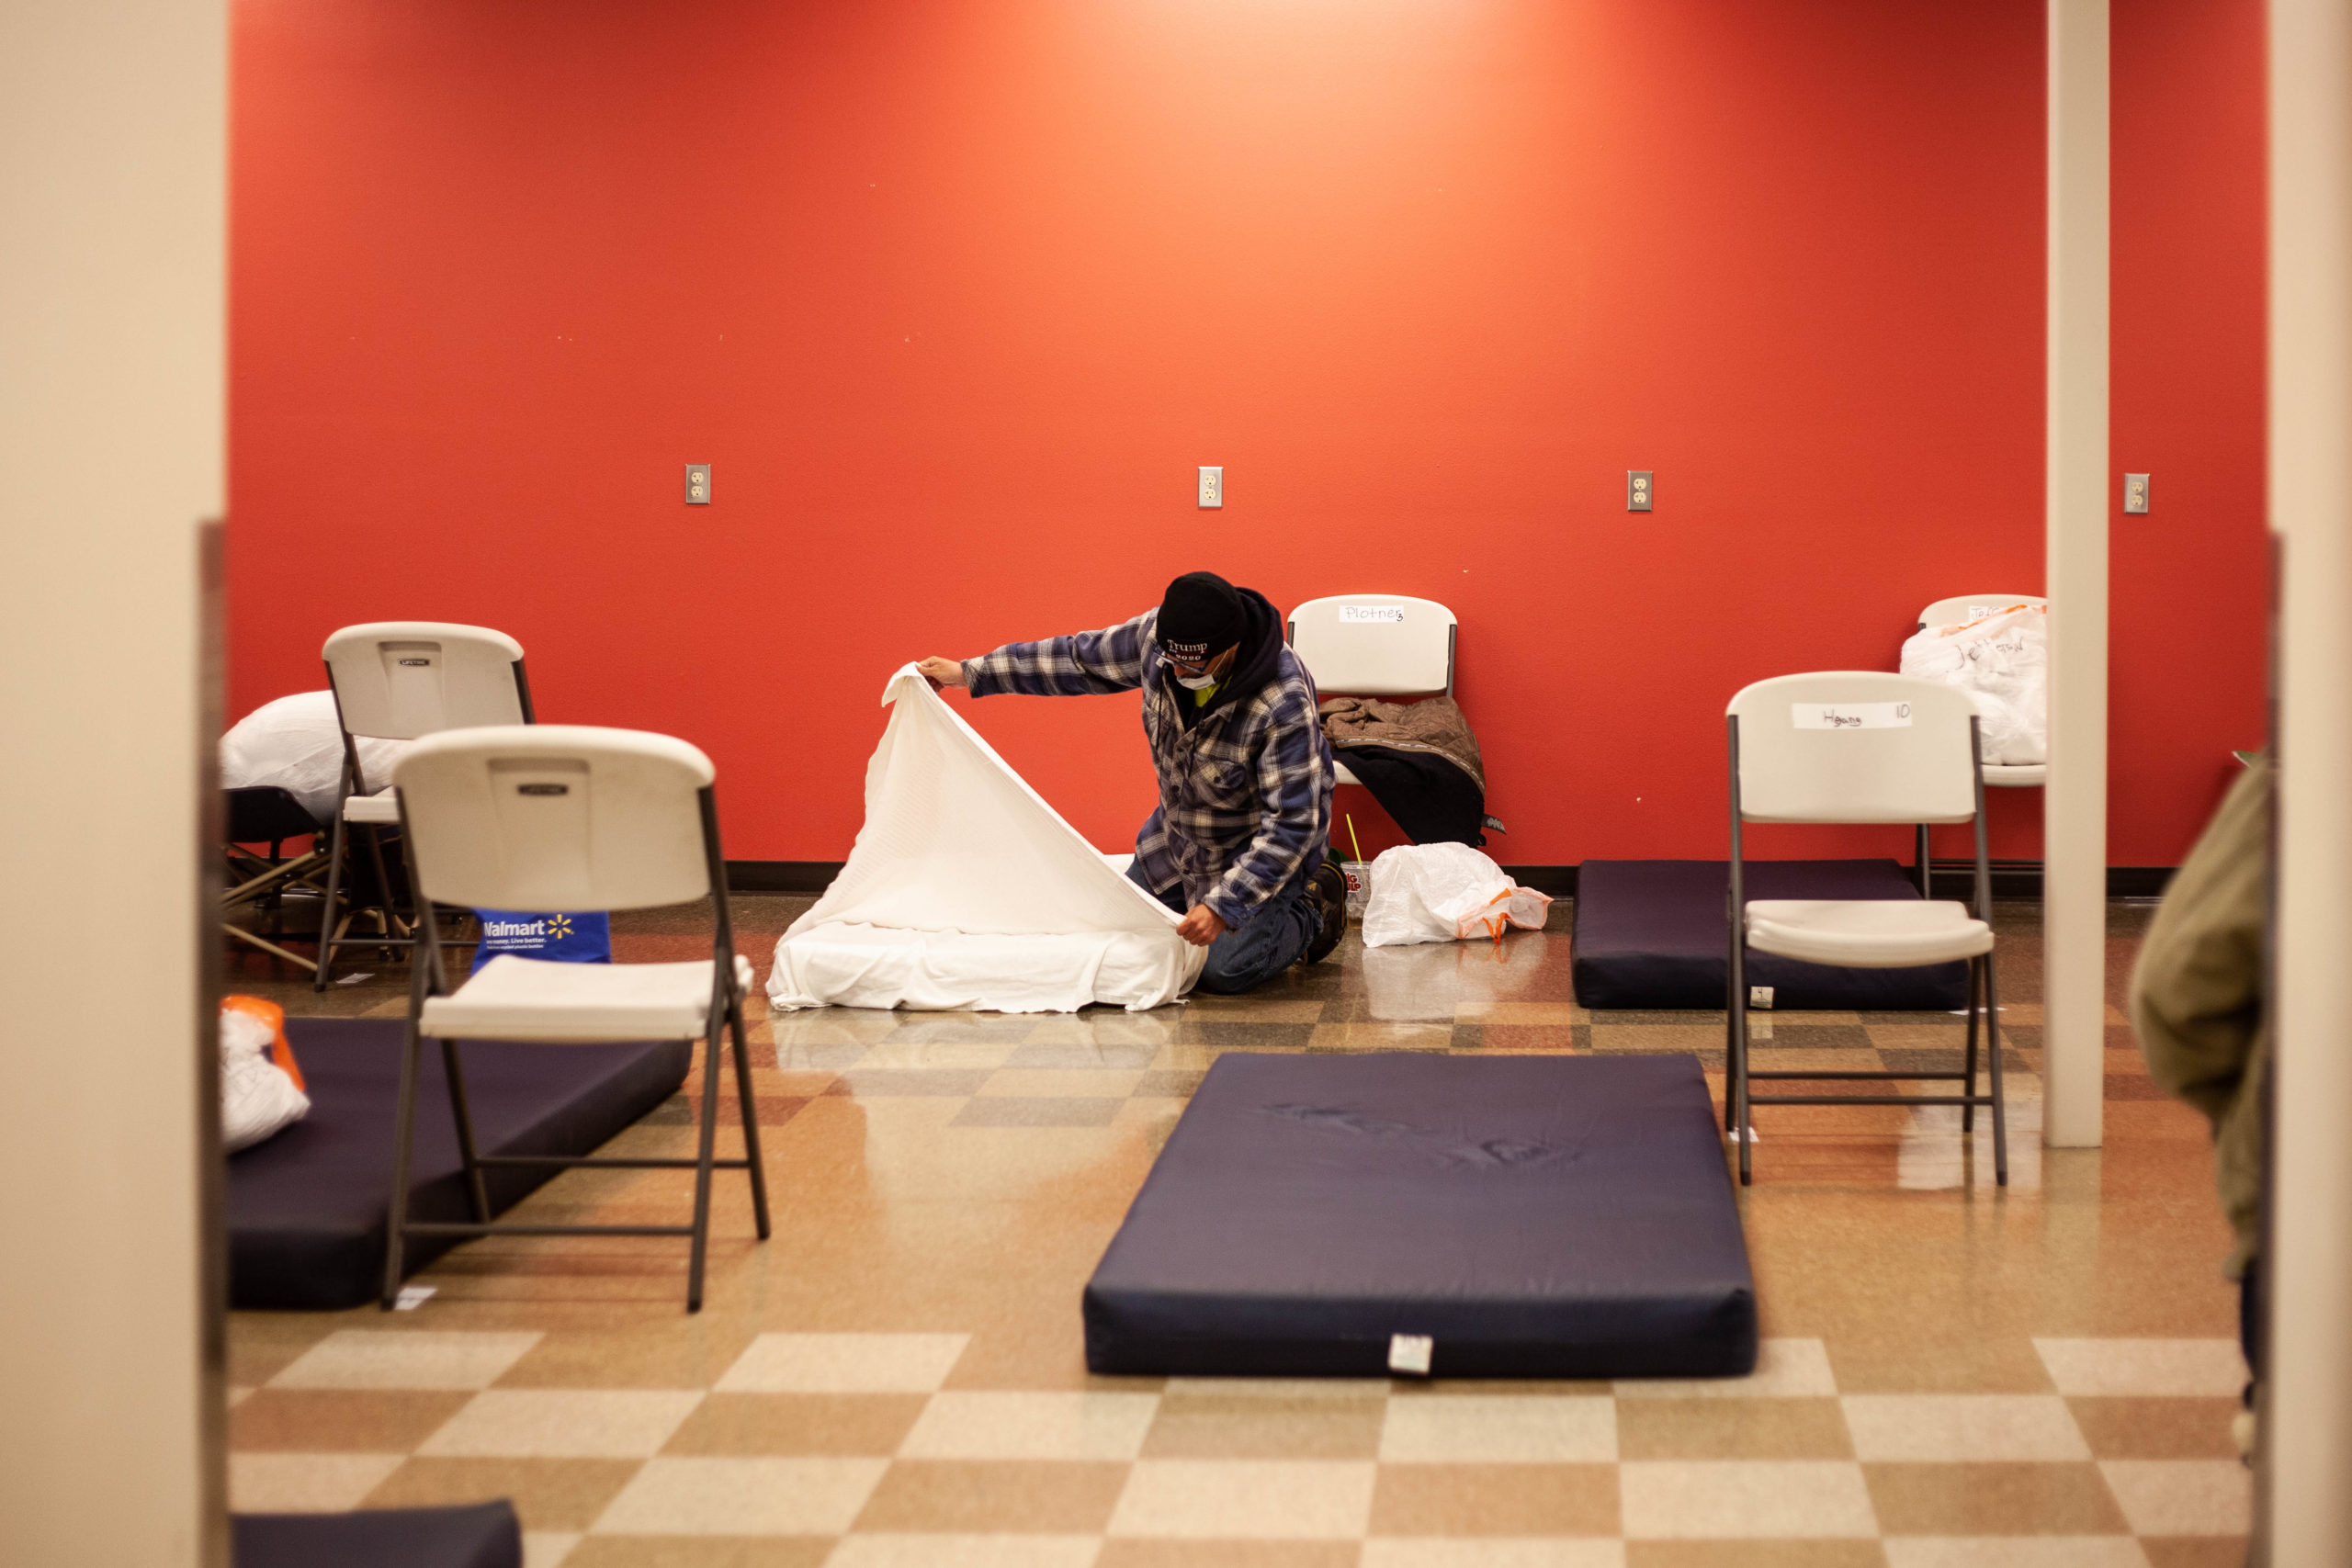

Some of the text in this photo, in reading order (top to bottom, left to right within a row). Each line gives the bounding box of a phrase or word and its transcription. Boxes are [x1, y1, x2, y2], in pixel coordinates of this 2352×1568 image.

[1345, 606, 1401, 618] Plotner
[1167, 638, 1207, 654] Trump
[1895, 704, 1910, 718] 10
